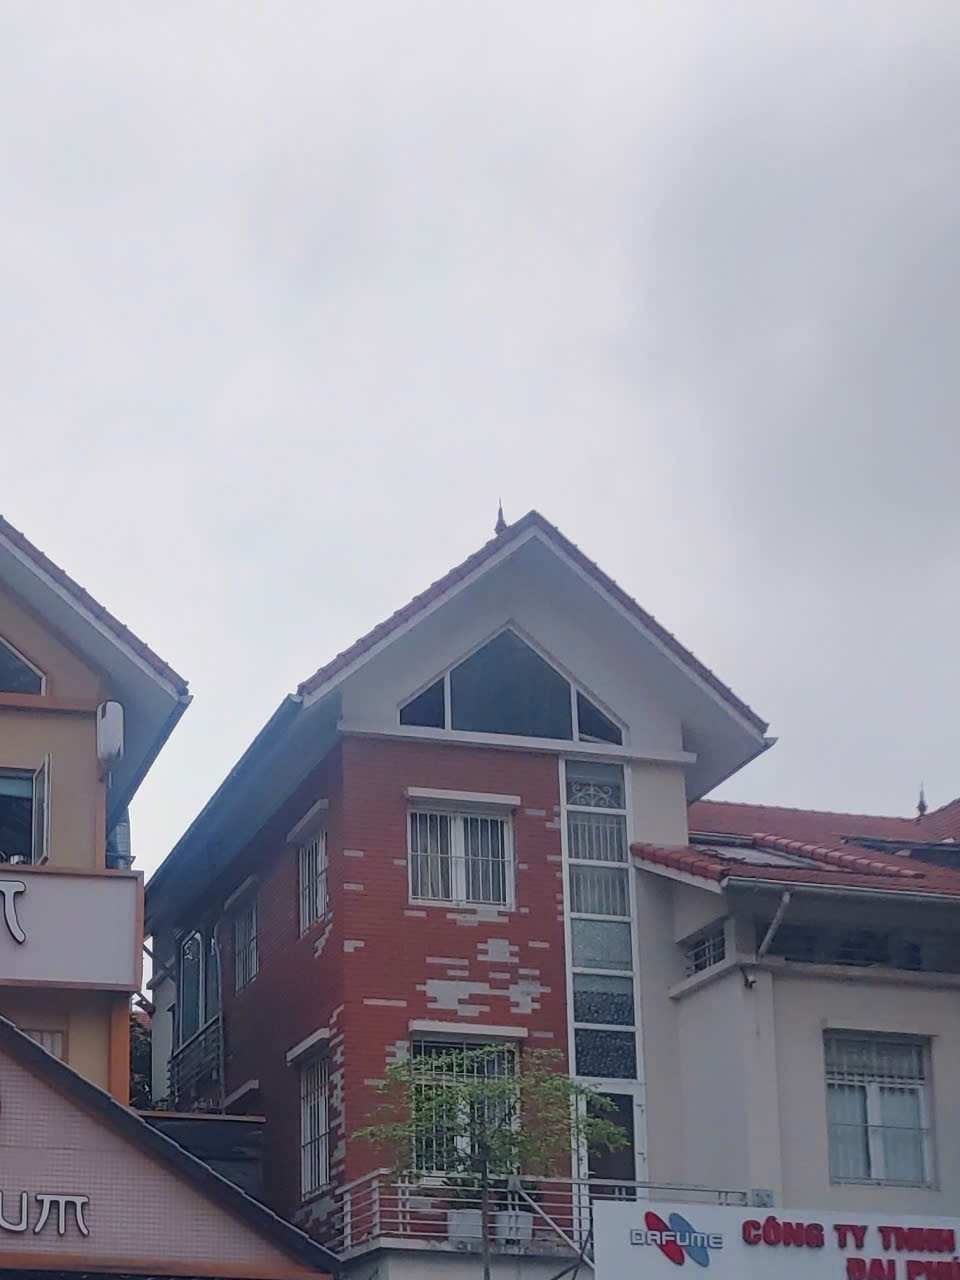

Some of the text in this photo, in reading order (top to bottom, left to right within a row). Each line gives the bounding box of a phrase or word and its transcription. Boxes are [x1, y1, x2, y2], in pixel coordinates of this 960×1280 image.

[630, 1229, 724, 1249] DAFUME
[742, 1216, 955, 1252] CÔNG TY TNHH
